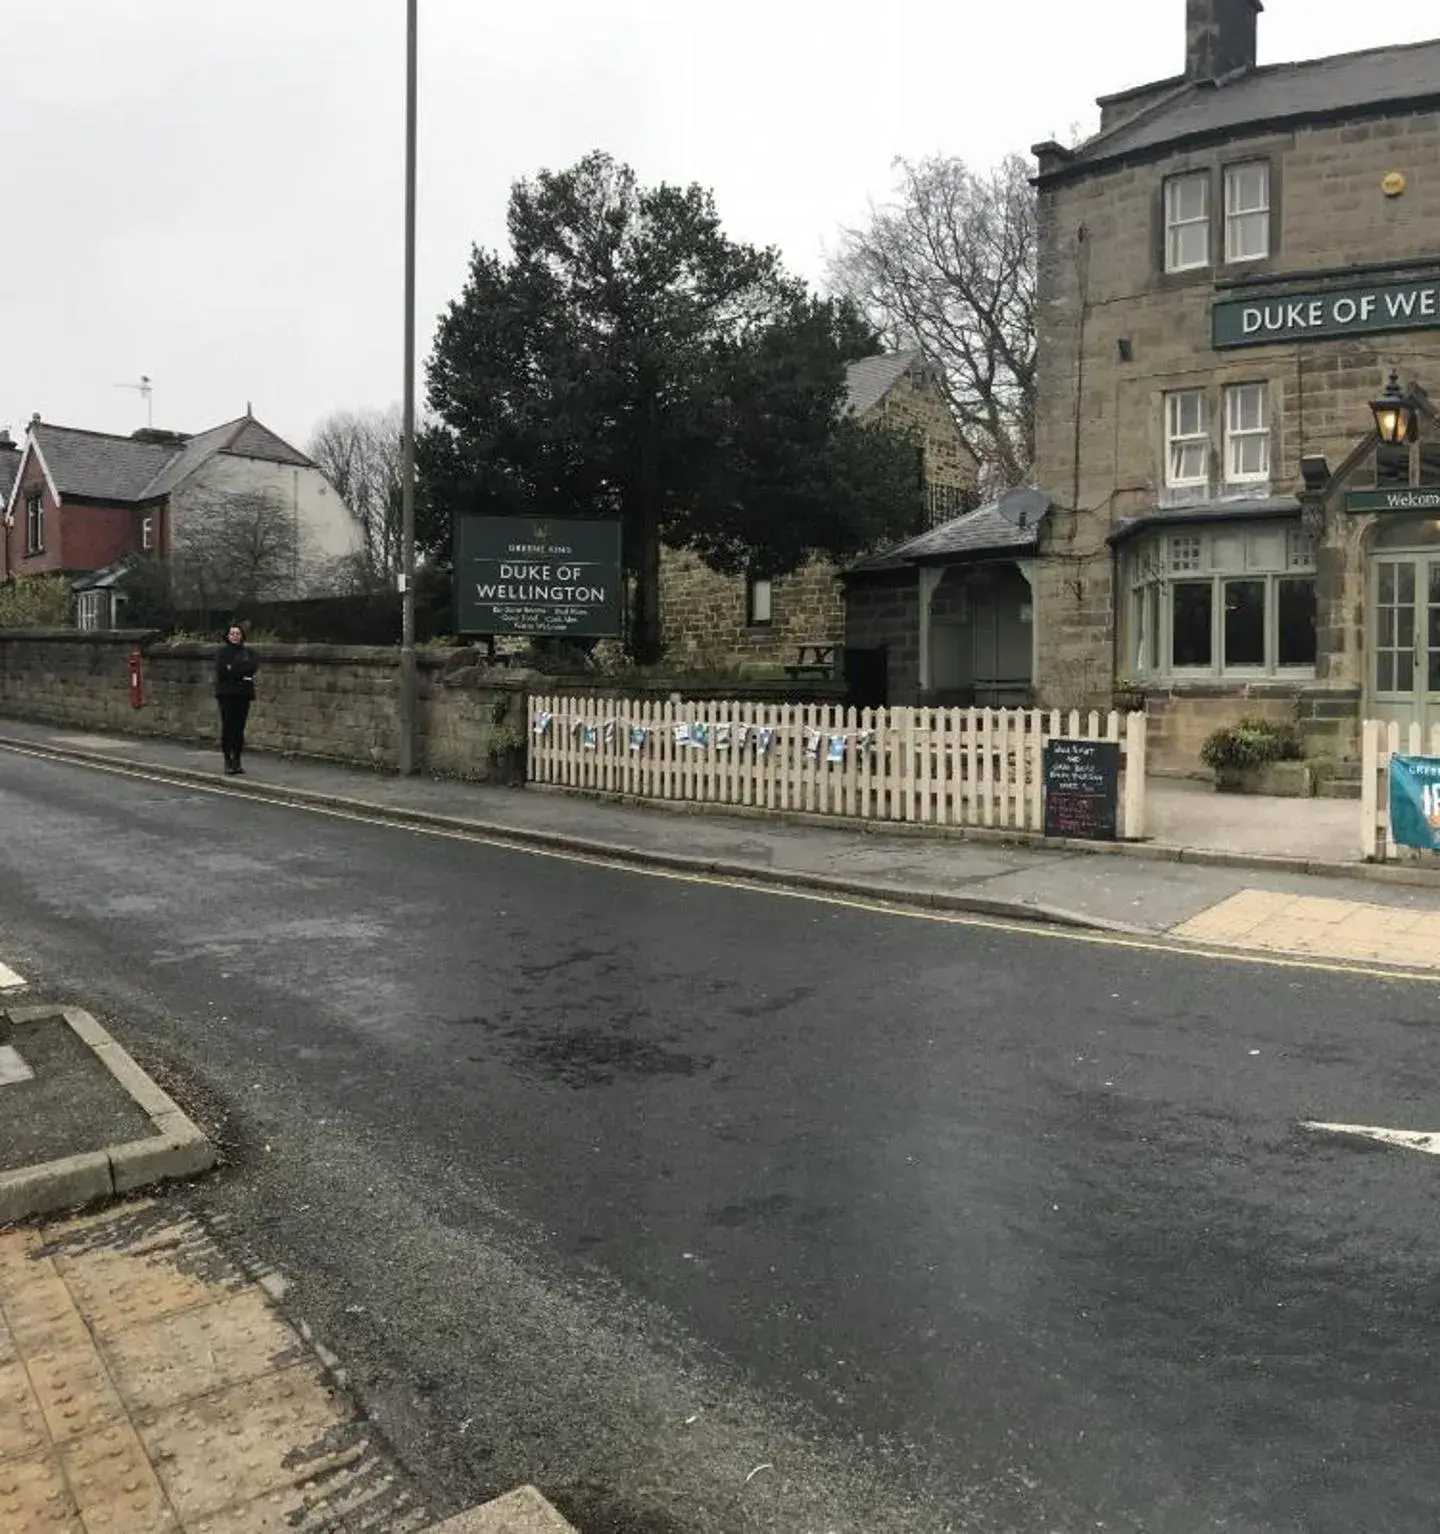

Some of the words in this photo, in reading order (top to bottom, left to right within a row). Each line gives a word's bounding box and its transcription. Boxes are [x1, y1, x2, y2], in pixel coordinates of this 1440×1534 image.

[1242, 300, 1323, 334] DUKE
[1332, 294, 1376, 323] OF
[500, 565, 550, 580] DUKE
[556, 566, 581, 580] OF
[476, 584, 604, 602] WELLINGTON
